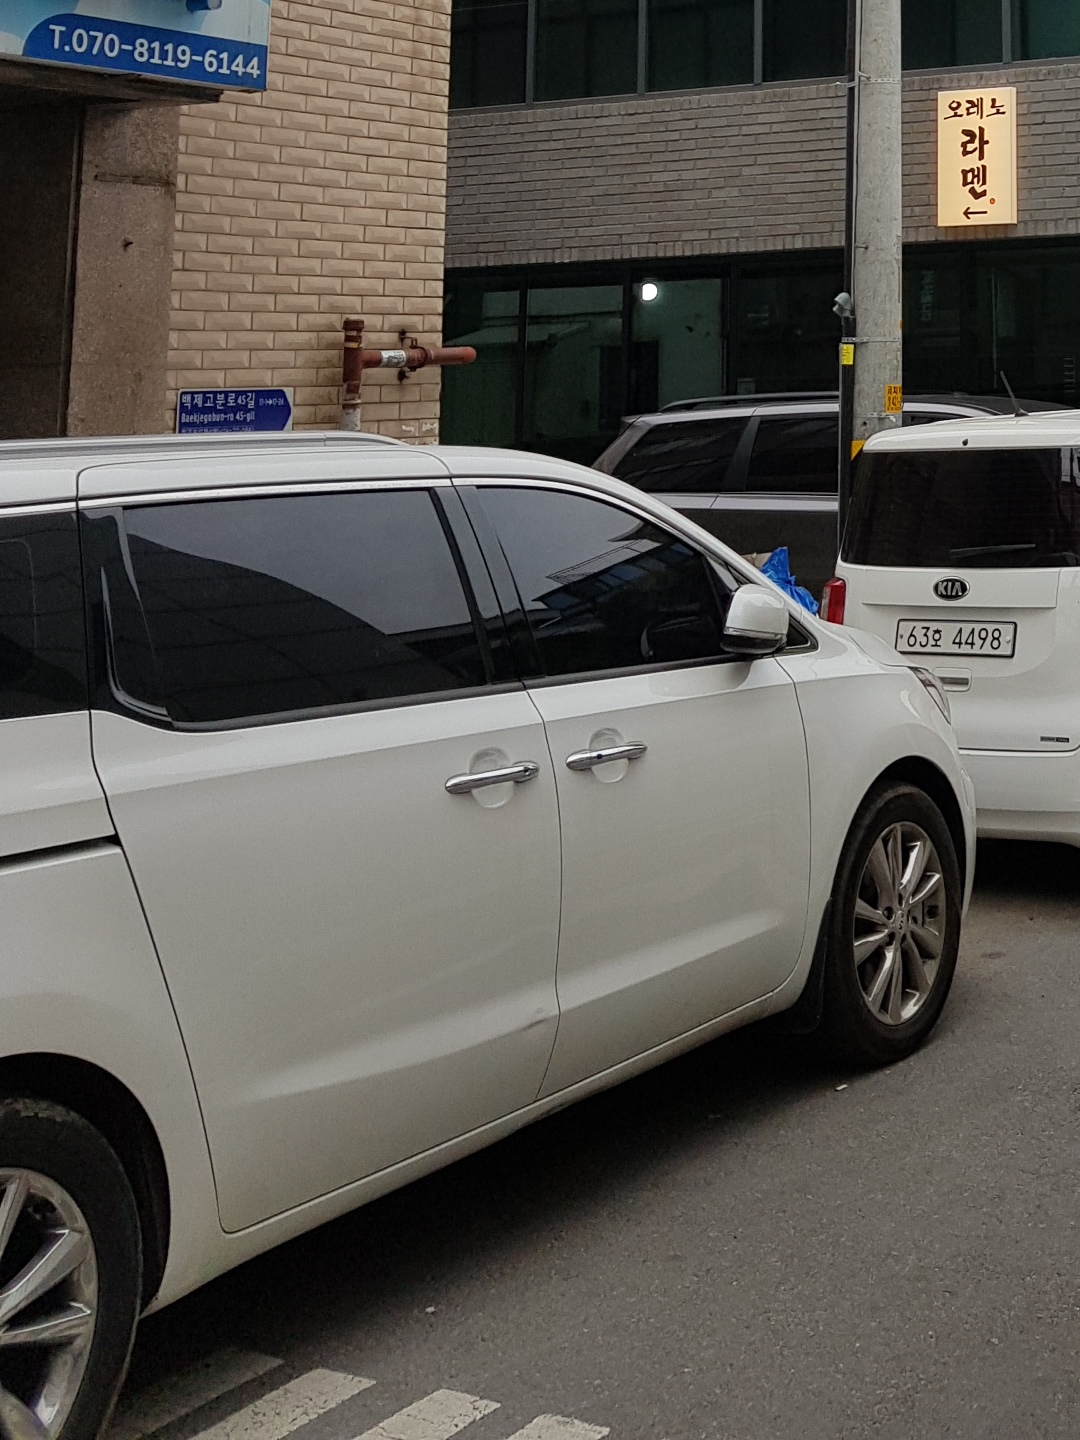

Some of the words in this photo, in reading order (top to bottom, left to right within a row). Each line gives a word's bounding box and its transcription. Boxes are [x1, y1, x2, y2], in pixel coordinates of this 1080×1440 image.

[49, 24, 260, 79] T.070-8119-6144
[944, 97, 1006, 121] 오레노
[960, 126, 990, 200] 라멘
[181, 392, 255, 410] 백제고분로45길
[937, 581, 963, 597] KIA
[907, 625, 943, 649] 63호
[952, 627, 1003, 650] 4498
